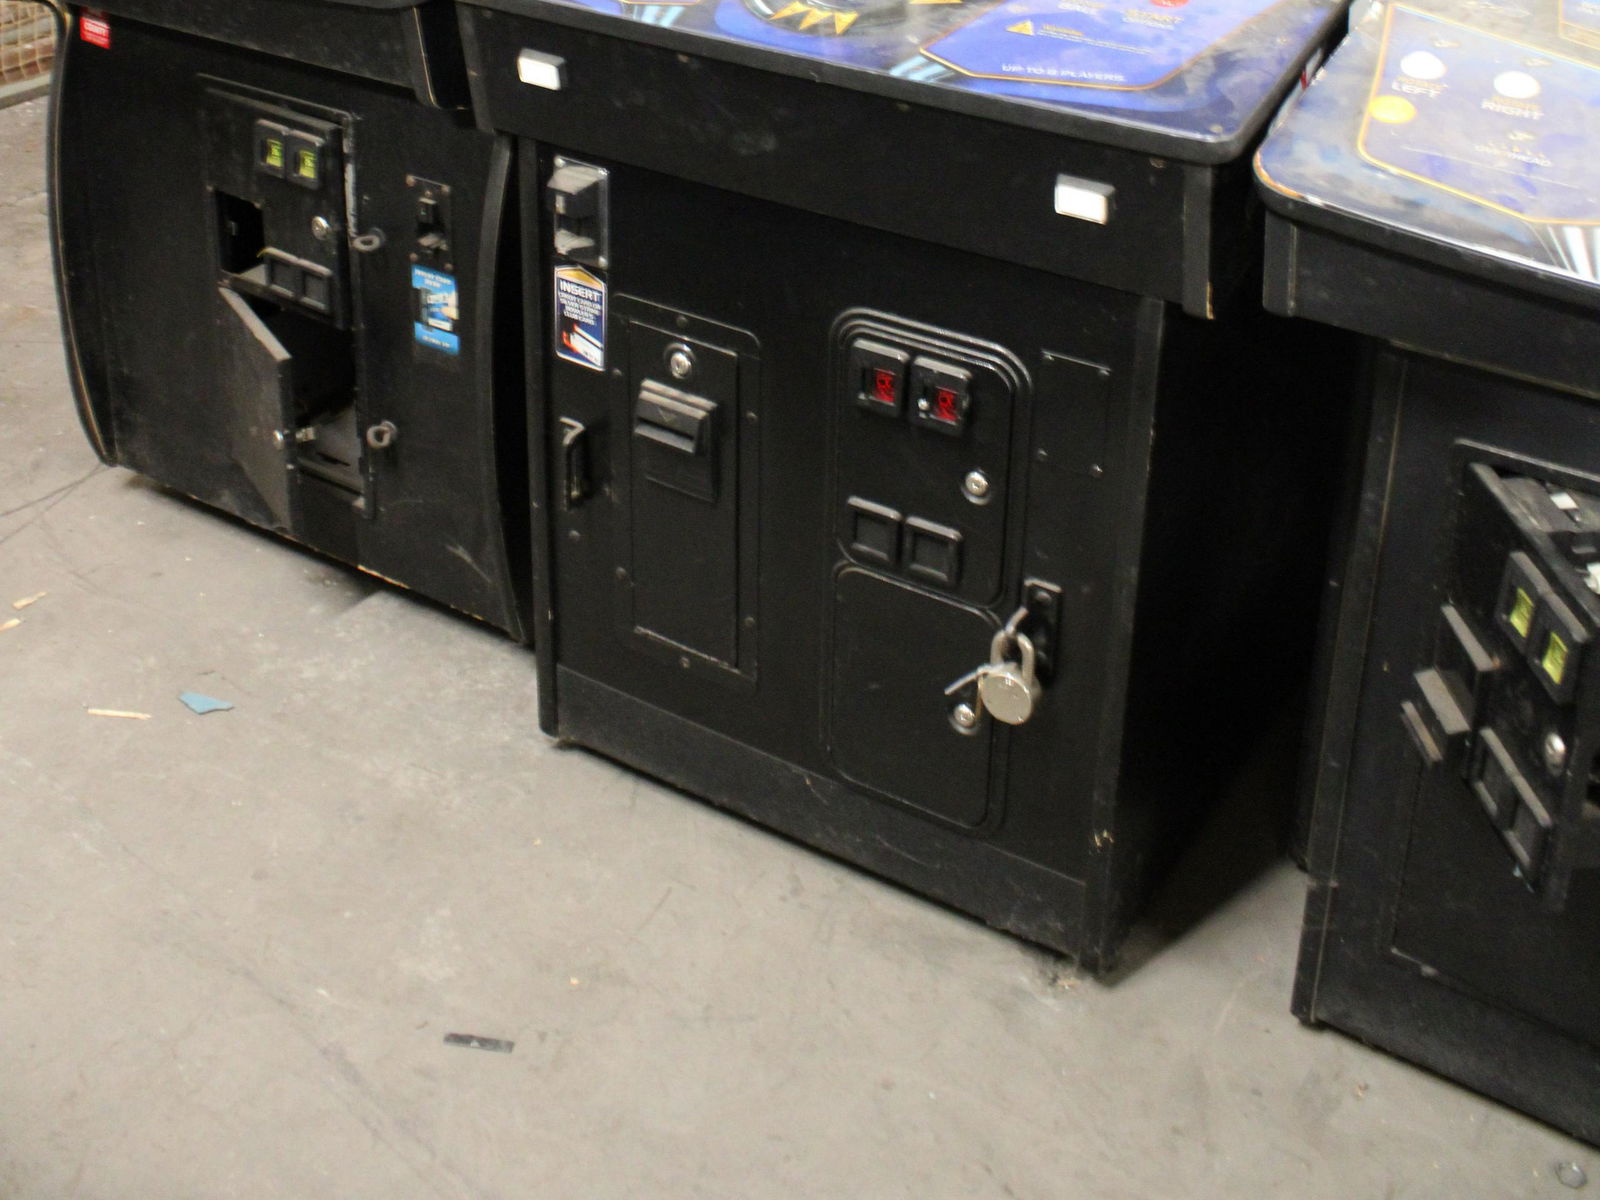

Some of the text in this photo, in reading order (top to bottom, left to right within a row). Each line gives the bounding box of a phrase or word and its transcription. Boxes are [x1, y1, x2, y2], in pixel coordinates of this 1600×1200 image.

[1001, 64, 1024, 73] UP
[1026, 66, 1045, 75] TO
[1060, 69, 1125, 81] PLAYERS
[560, 280, 602, 302] INSERT
